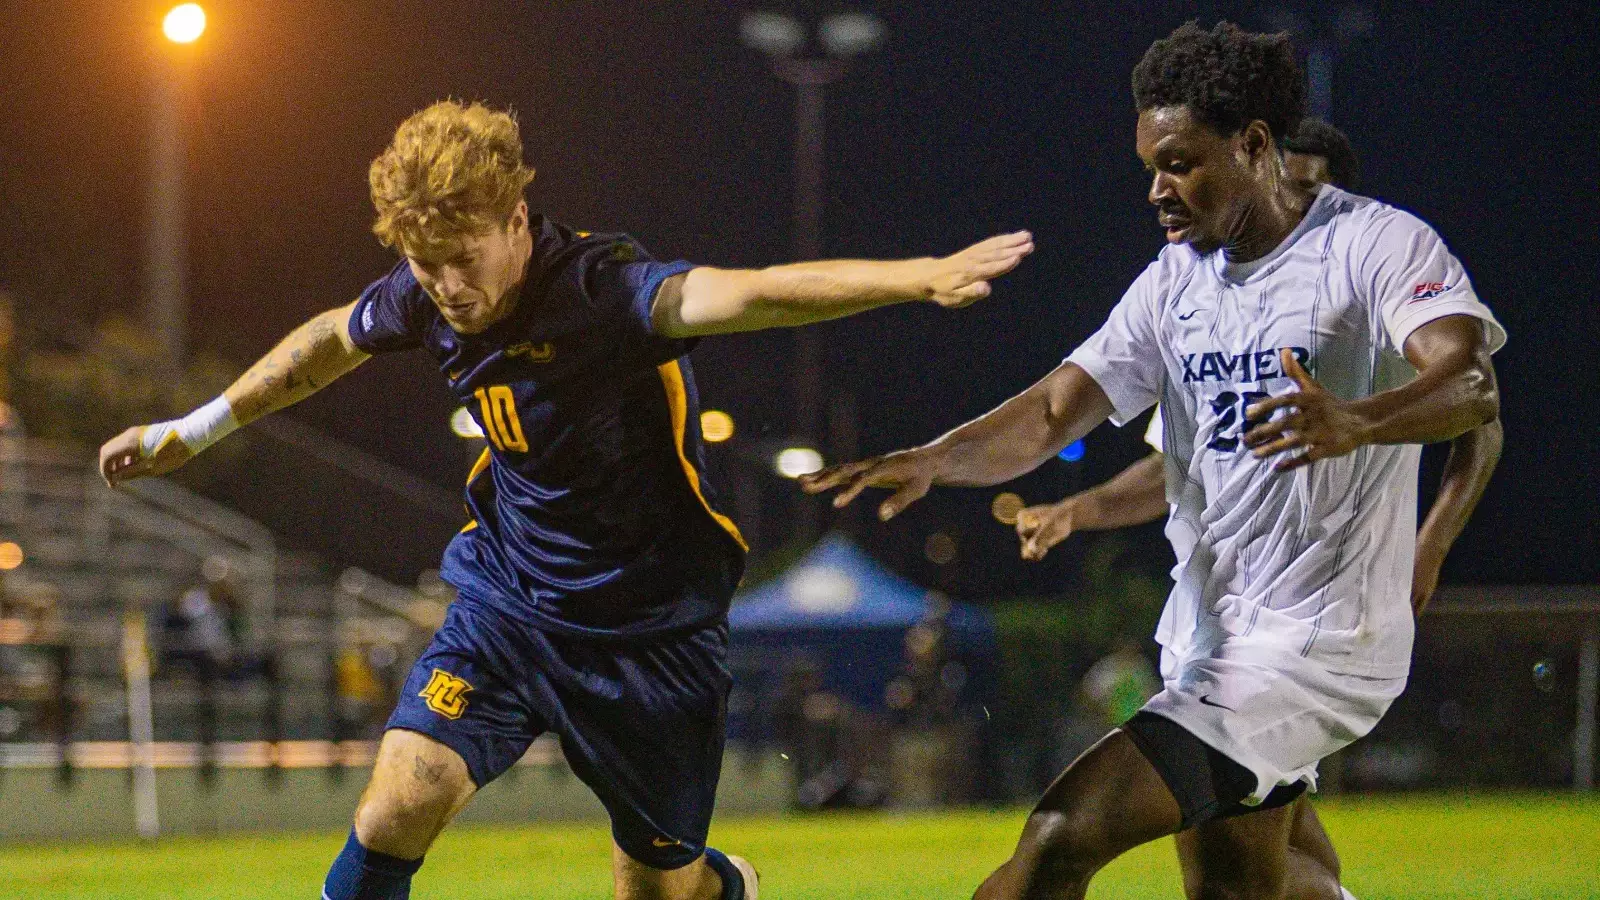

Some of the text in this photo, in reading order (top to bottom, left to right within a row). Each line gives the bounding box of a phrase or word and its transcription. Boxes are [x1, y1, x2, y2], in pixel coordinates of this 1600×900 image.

[1180, 347, 1312, 383] XAVIER
[474, 385, 529, 453] 10
[418, 668, 474, 720] MU
